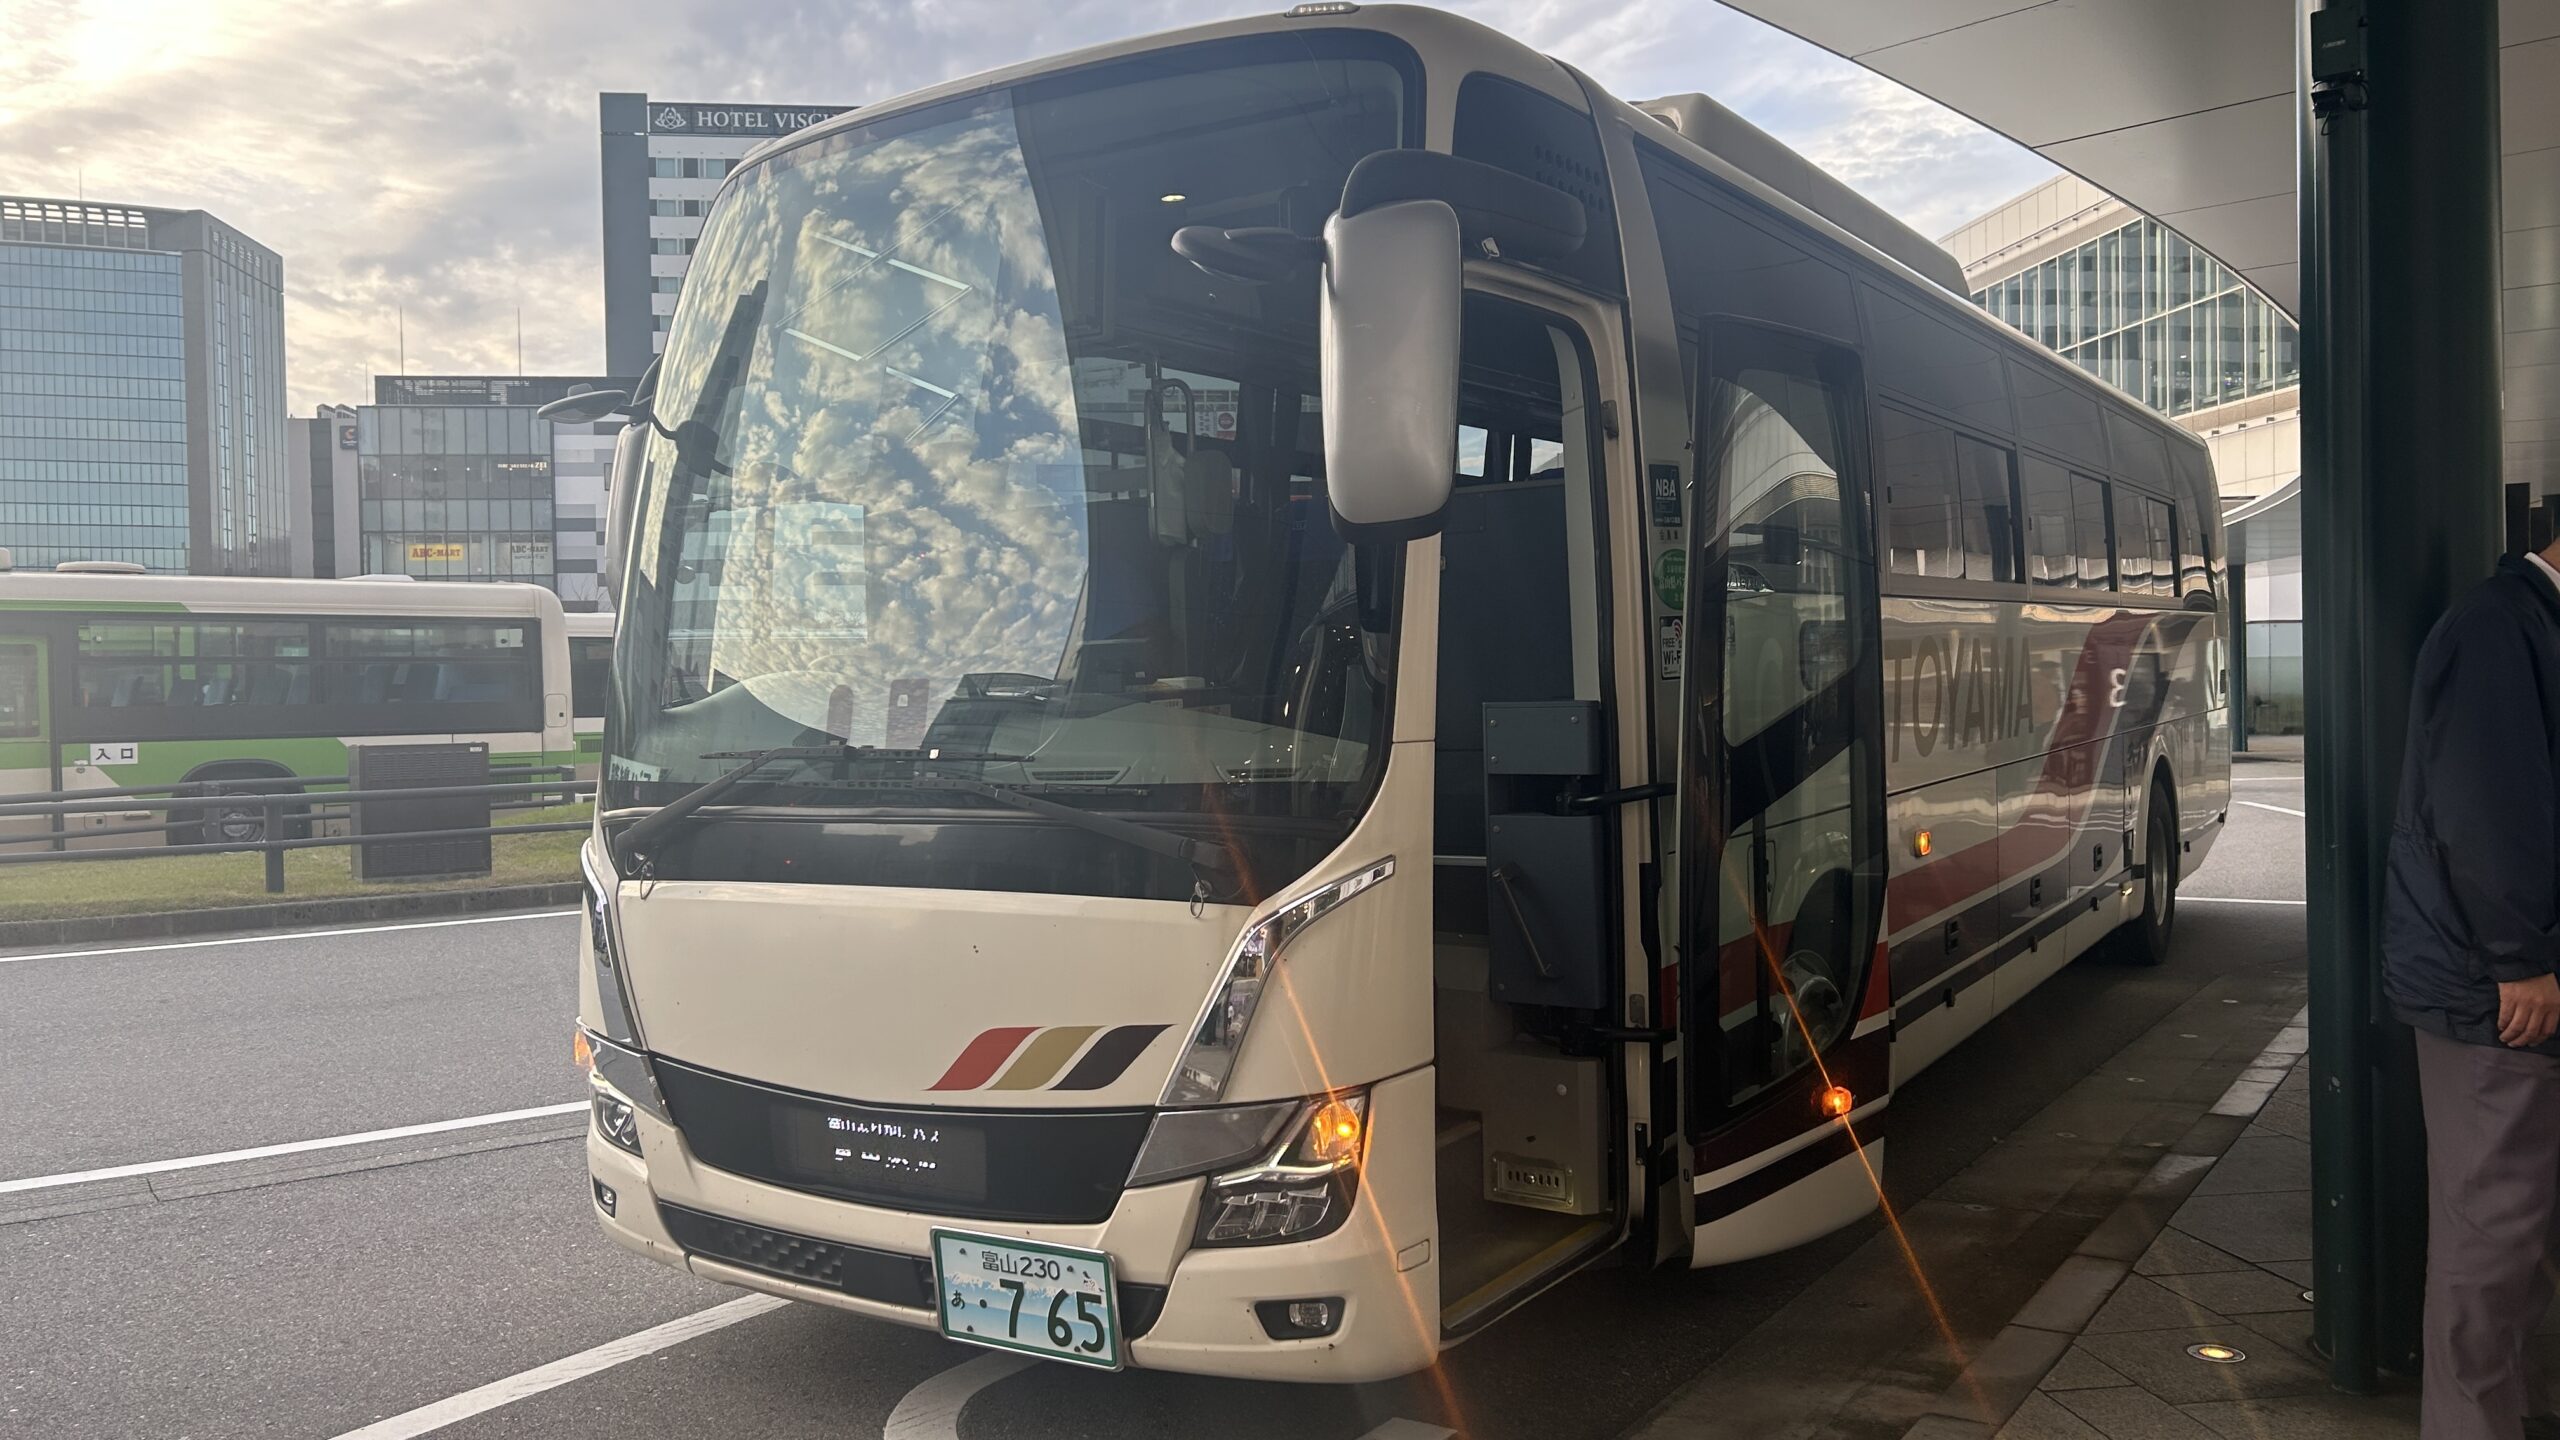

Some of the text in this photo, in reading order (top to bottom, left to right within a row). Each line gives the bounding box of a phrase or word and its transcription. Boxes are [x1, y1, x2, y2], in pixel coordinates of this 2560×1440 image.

[698, 111, 768, 128] HOTEL
[1655, 478, 1676, 497] NBA
[412, 548, 461, 558] ABC-MART
[1884, 635, 2034, 763] TOYAMA
[96, 747, 133, 760] 入口
[951, 1290, 965, 1310] あ
